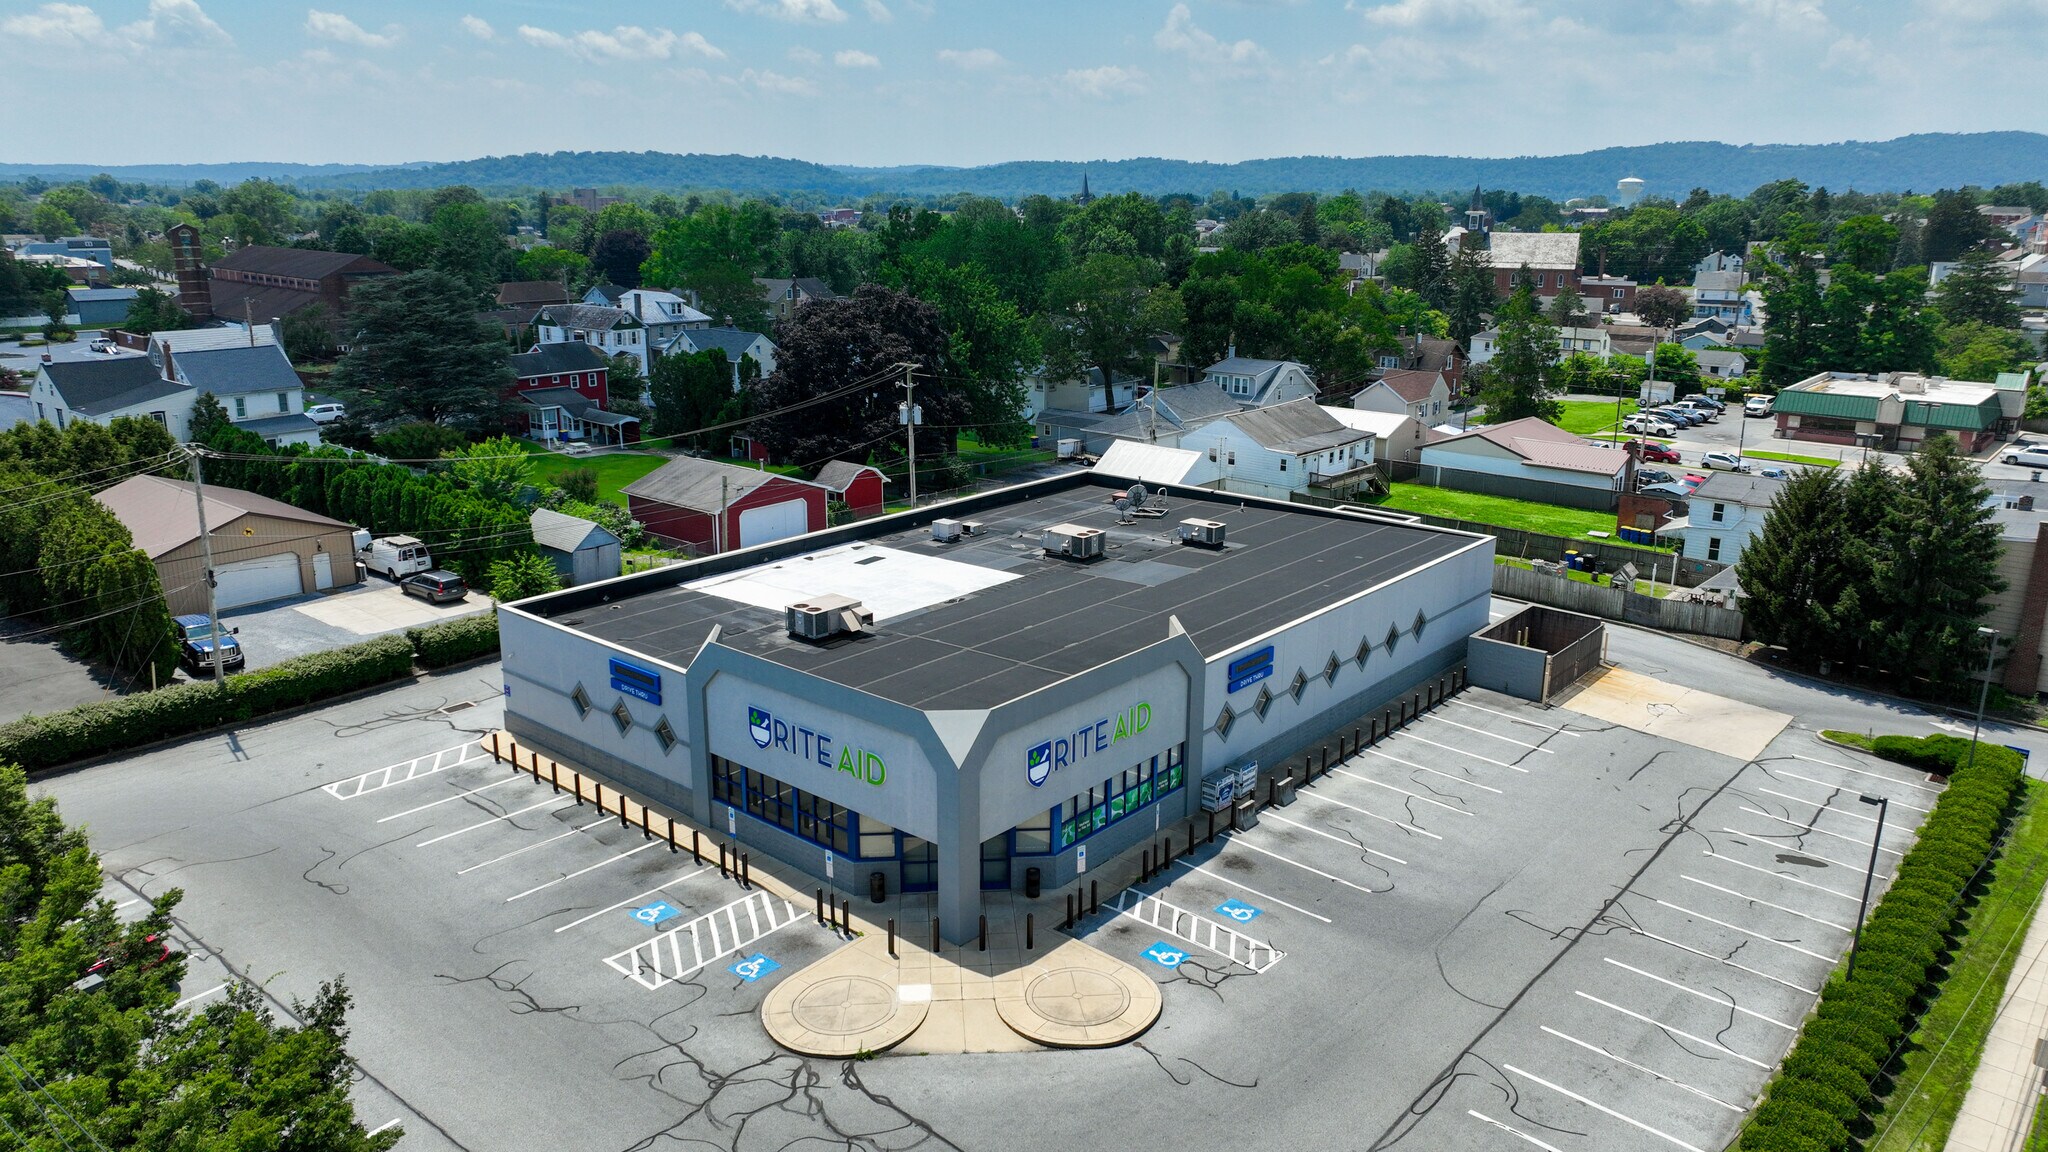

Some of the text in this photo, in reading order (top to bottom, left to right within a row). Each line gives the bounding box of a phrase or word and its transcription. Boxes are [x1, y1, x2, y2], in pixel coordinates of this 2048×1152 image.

[621, 684, 649, 700] DRIVE THRU
[1240, 671, 1265, 687] DRIVE THRU
[774, 717, 887, 786] RITE AID
[1053, 701, 1152, 772] RITE AID
